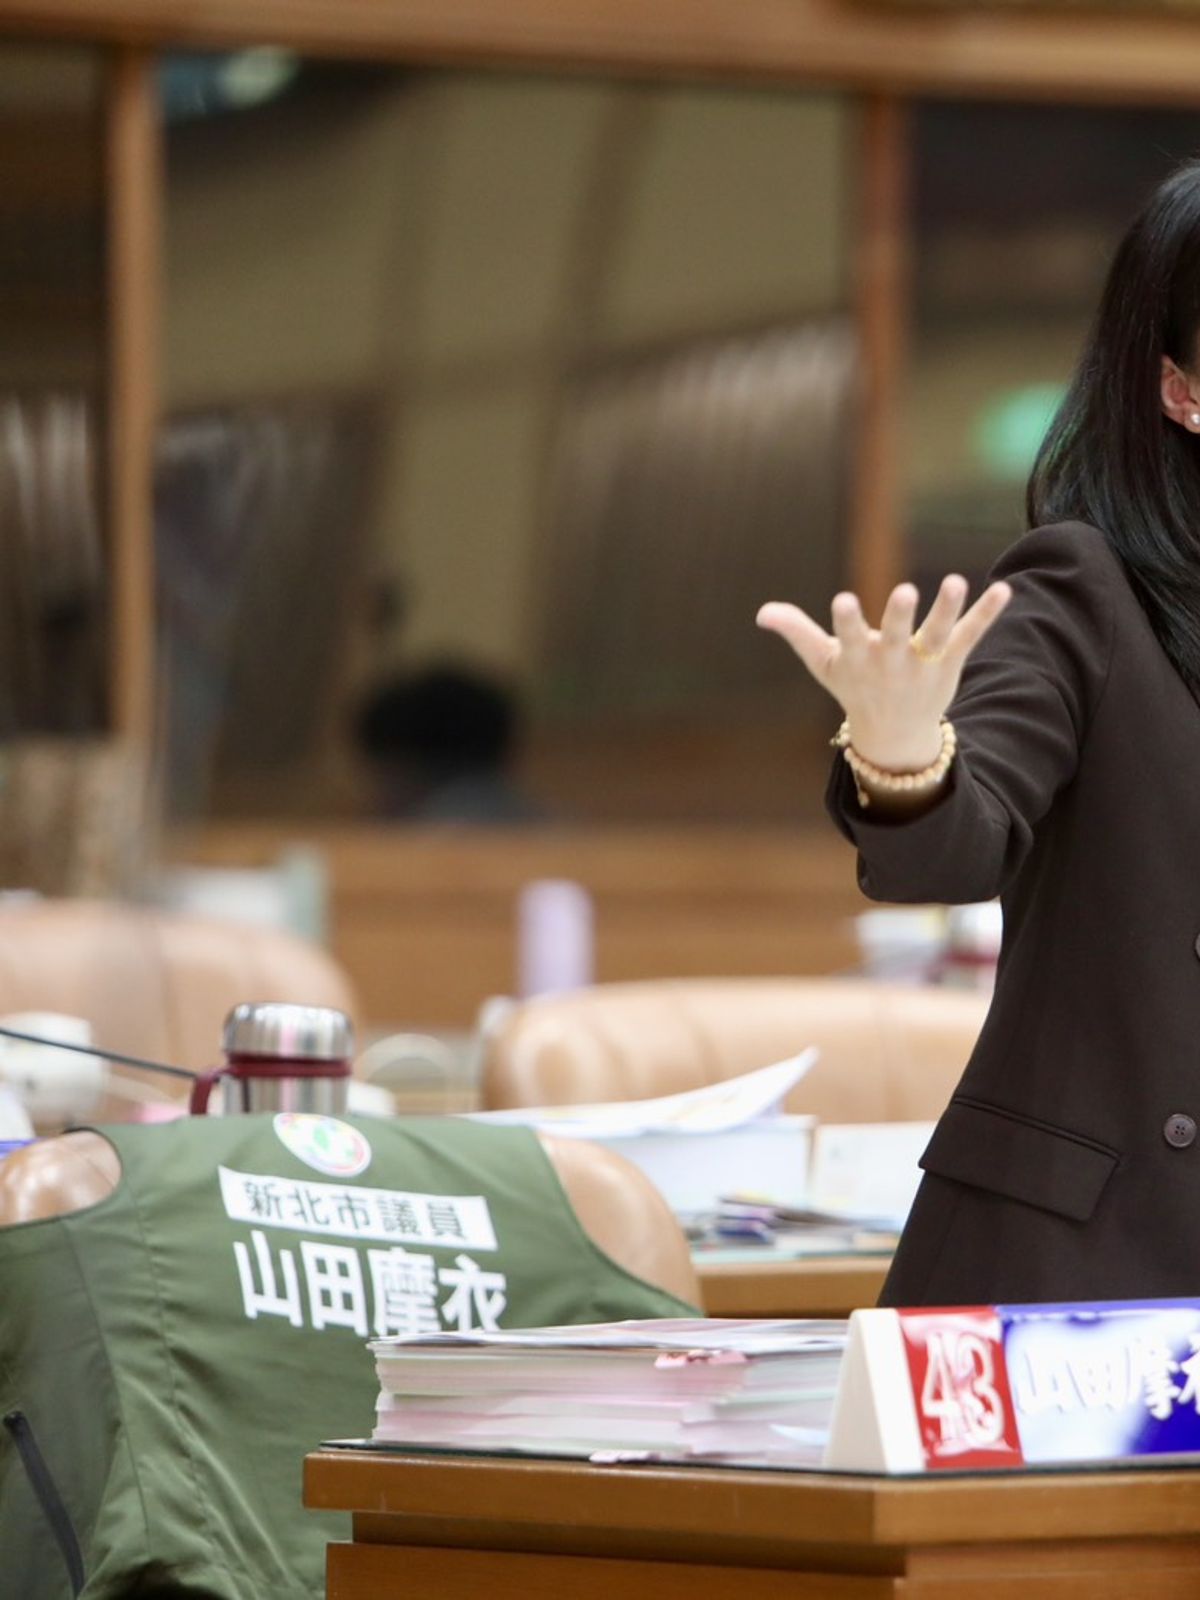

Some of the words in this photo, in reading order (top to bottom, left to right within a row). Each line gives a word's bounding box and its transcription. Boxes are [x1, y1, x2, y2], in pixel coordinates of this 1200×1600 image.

[243, 1182, 467, 1242] 新北市議員
[232, 1230, 508, 1337] 山田摩衣
[921, 1331, 1004, 1447] 43
